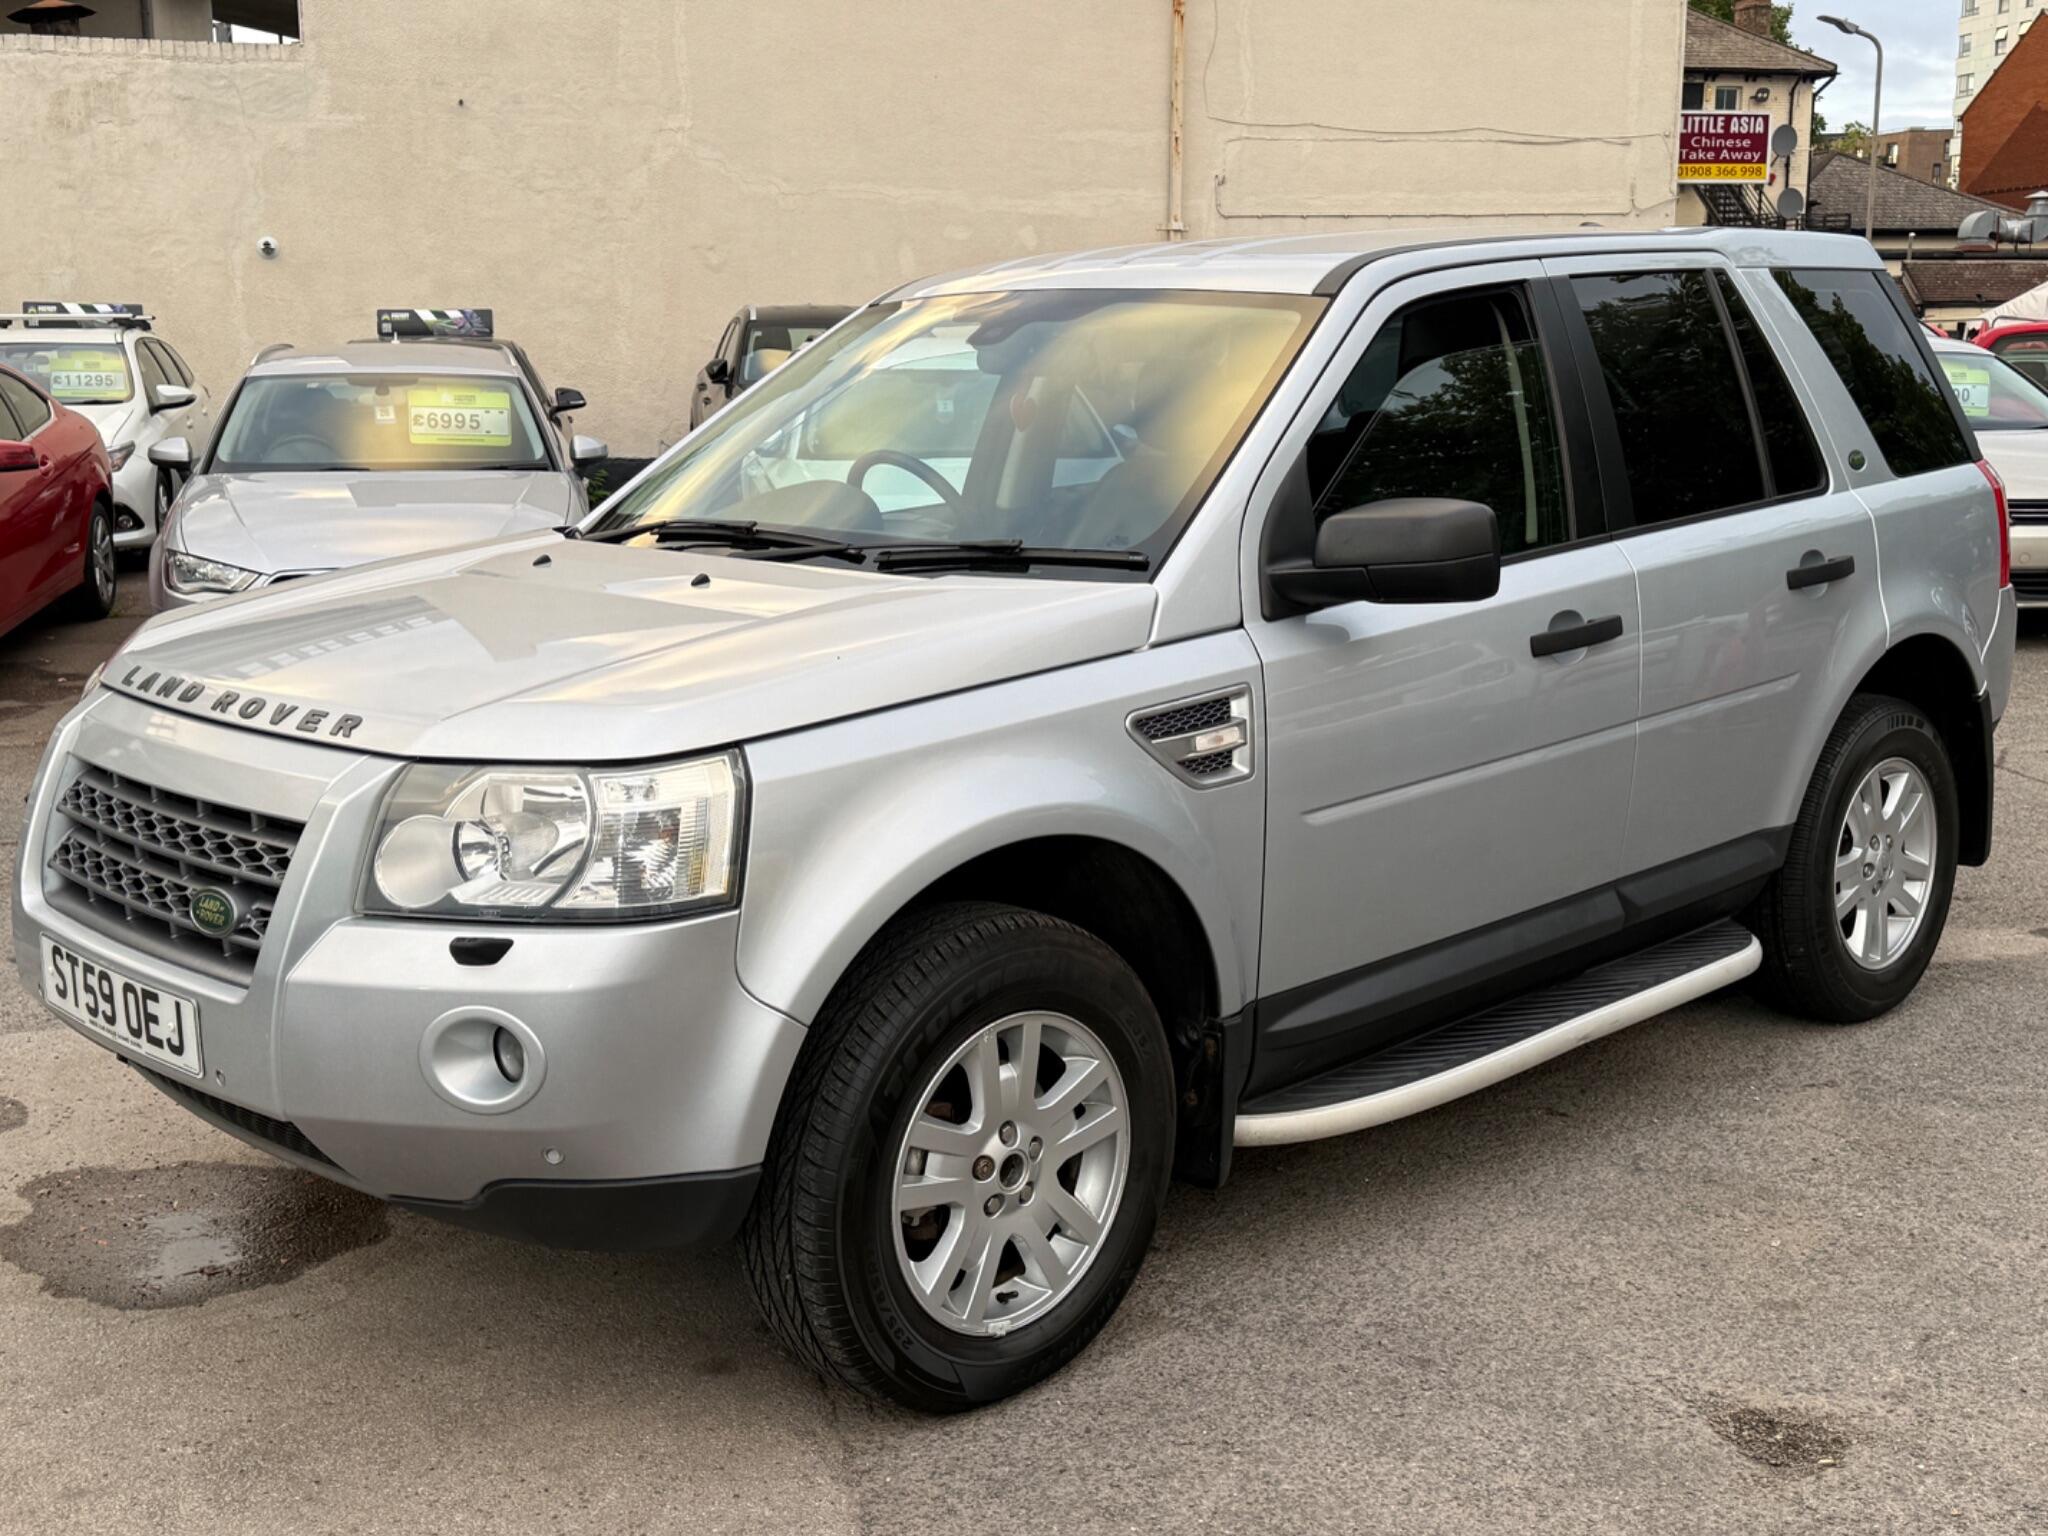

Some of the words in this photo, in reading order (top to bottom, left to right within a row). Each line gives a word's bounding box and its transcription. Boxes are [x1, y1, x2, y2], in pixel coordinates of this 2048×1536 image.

[1681, 116, 1724, 133] LITTLE
[1730, 116, 1764, 133] ASIA
[1691, 136, 1751, 147] Chinese
[1681, 149, 1715, 160] Take
[1720, 150, 1761, 162] Away
[1716, 167, 1736, 176] 366
[1741, 166, 1762, 176] 998
[53, 374, 114, 387] £11295
[413, 412, 481, 430] £6995
[121, 665, 206, 702] LAND
[210, 690, 363, 737] ROVER
[52, 945, 116, 1027] ST59
[123, 981, 184, 1057] OEJ
